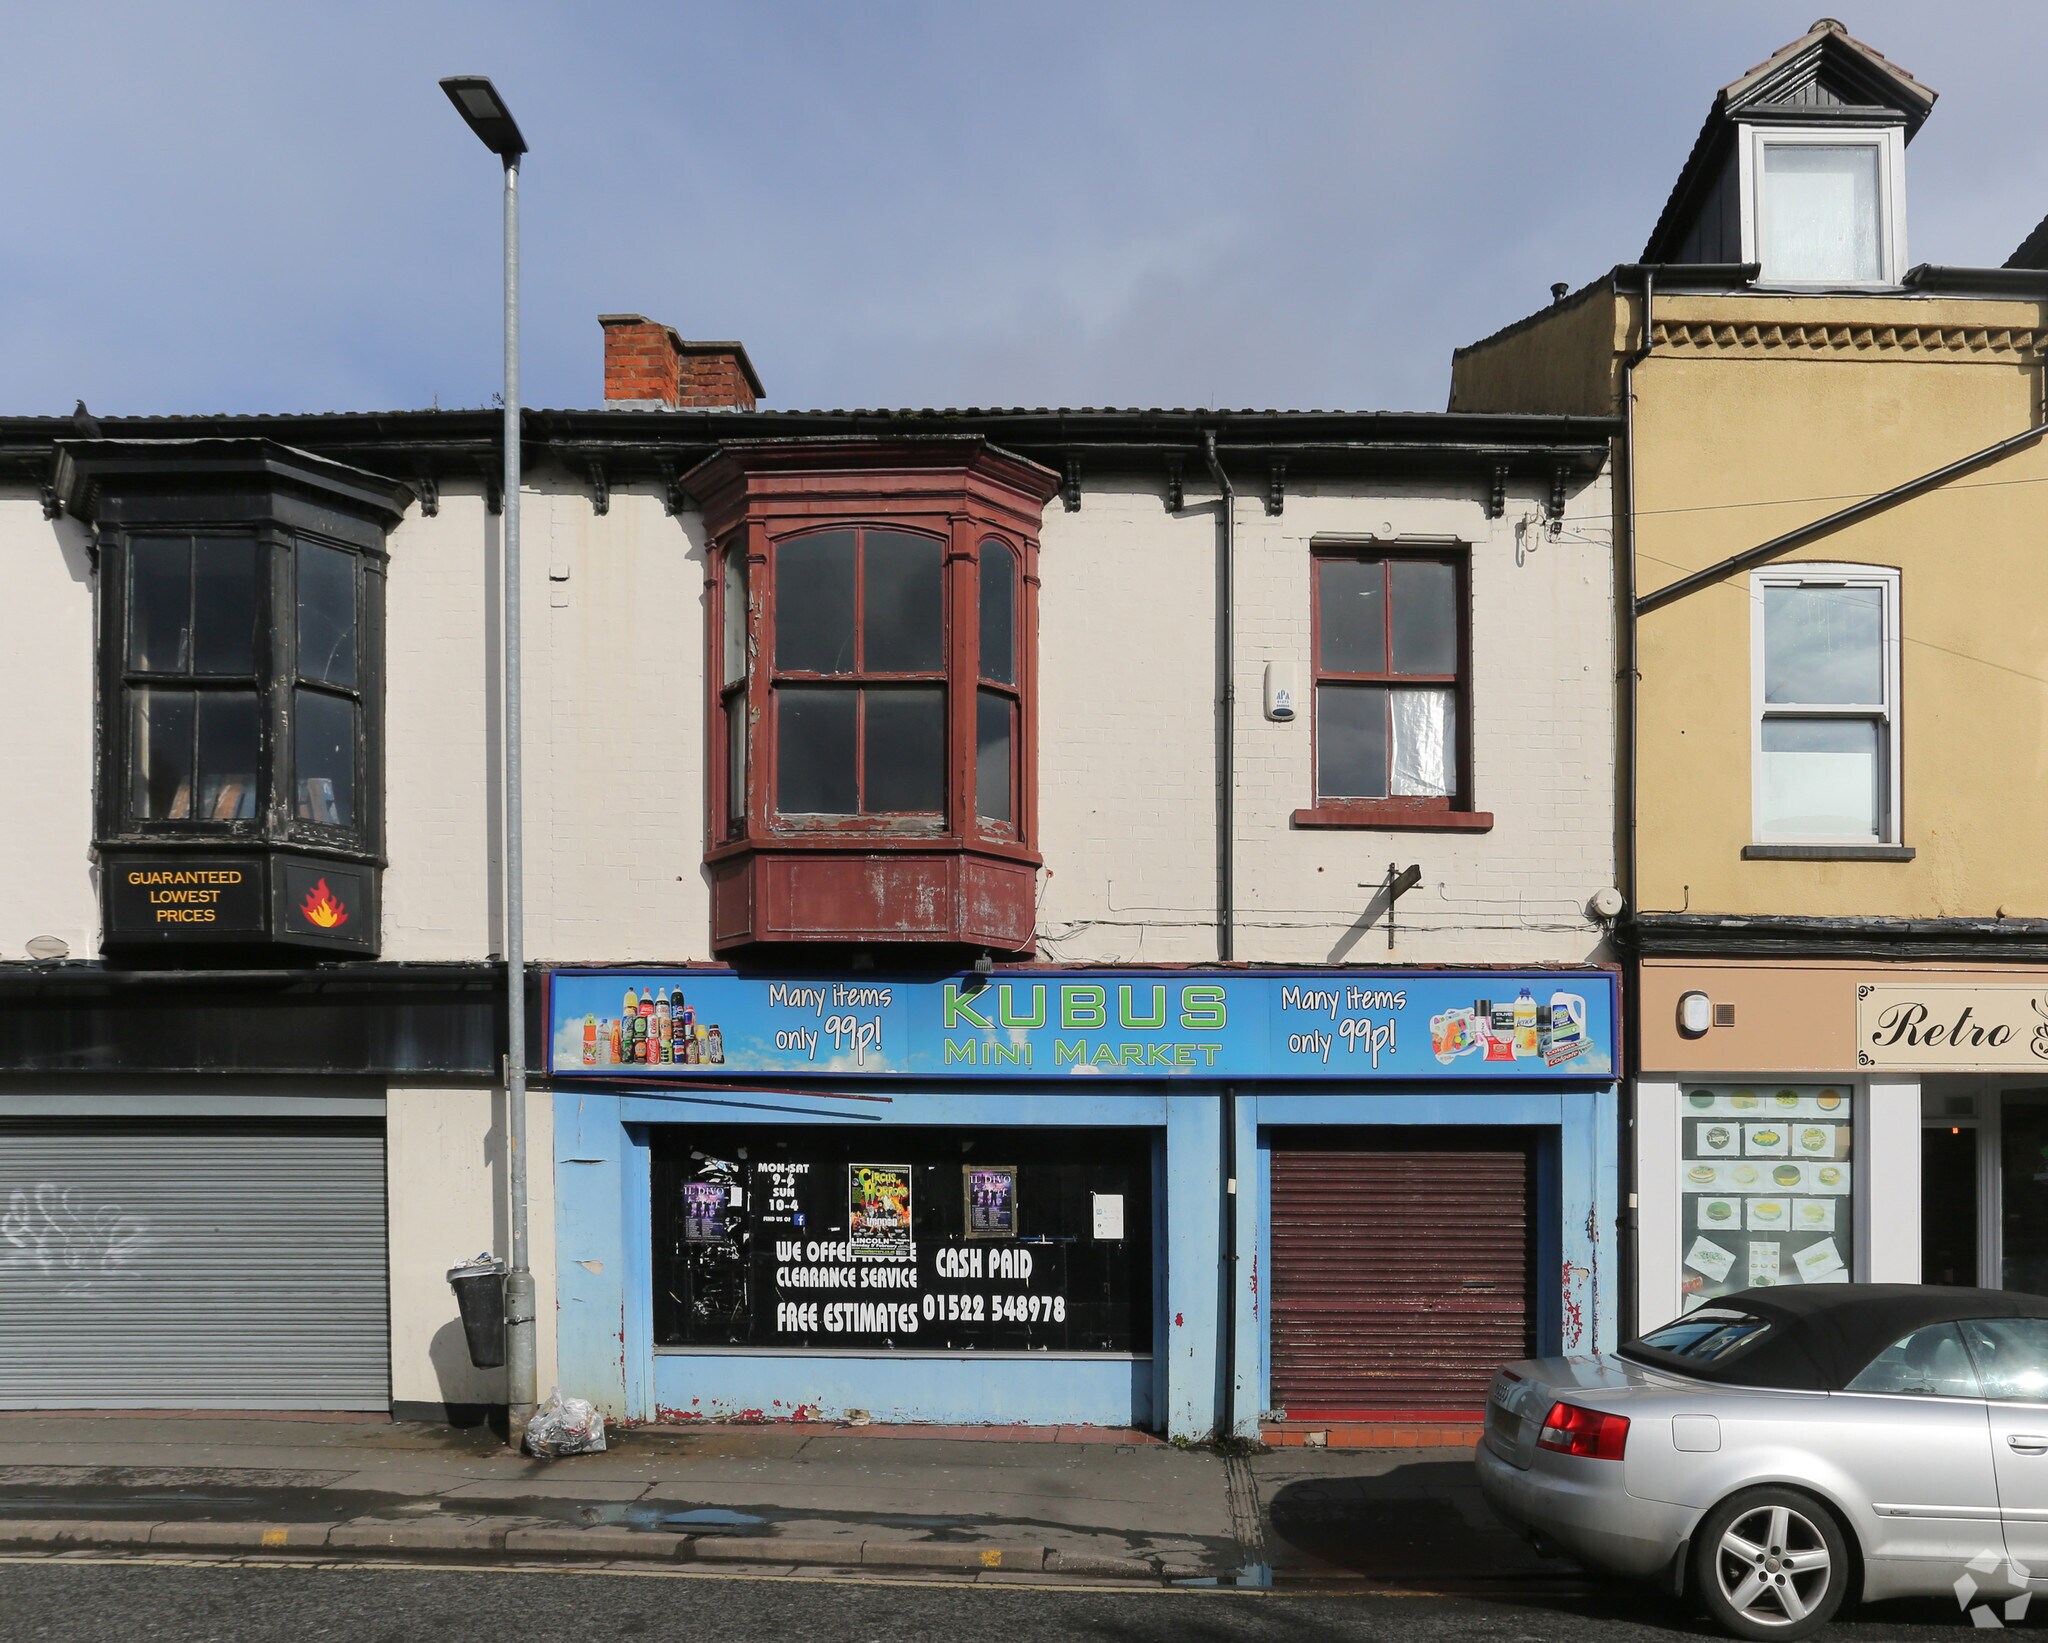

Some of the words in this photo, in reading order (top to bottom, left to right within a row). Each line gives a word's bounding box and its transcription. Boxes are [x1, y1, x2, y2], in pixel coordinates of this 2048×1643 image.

[128, 871, 242, 885] GUARANTEED
[150, 890, 221, 903] LOWEST
[156, 909, 216, 923] PRICES
[768, 983, 826, 1017] Many
[831, 983, 893, 1008] items
[943, 983, 1227, 1030] KUBUS
[1281, 985, 1340, 1020] Many
[1345, 986, 1407, 1012] items
[1871, 1001, 2023, 1047] Retro
[775, 1026, 818, 1060] only
[824, 1014, 883, 1067] 99p!
[1288, 1029, 1332, 1064] only
[1338, 1018, 1397, 1069] 99p!
[757, 1163, 810, 1174] MON-SAT
[772, 1173, 796, 1187] 9-6
[984, 1175, 1011, 1184] DIVO
[698, 1187, 724, 1195] DIVO
[772, 1188, 795, 1198] SUN
[768, 1199, 799, 1212] 10-4
[776, 1241, 801, 1261] WE
[851, 1237, 890, 1245] LINCOLN
[935, 1248, 982, 1278] CASH
[988, 1249, 1033, 1278] PAID
[776, 1267, 856, 1288] CLEARANCE
[860, 1267, 917, 1288] SERVICE
[777, 1302, 818, 1332] FREE
[823, 1302, 918, 1332] ESTIMATES
[923, 1294, 984, 1321] 01522
[991, 1295, 1066, 1322] 548978
